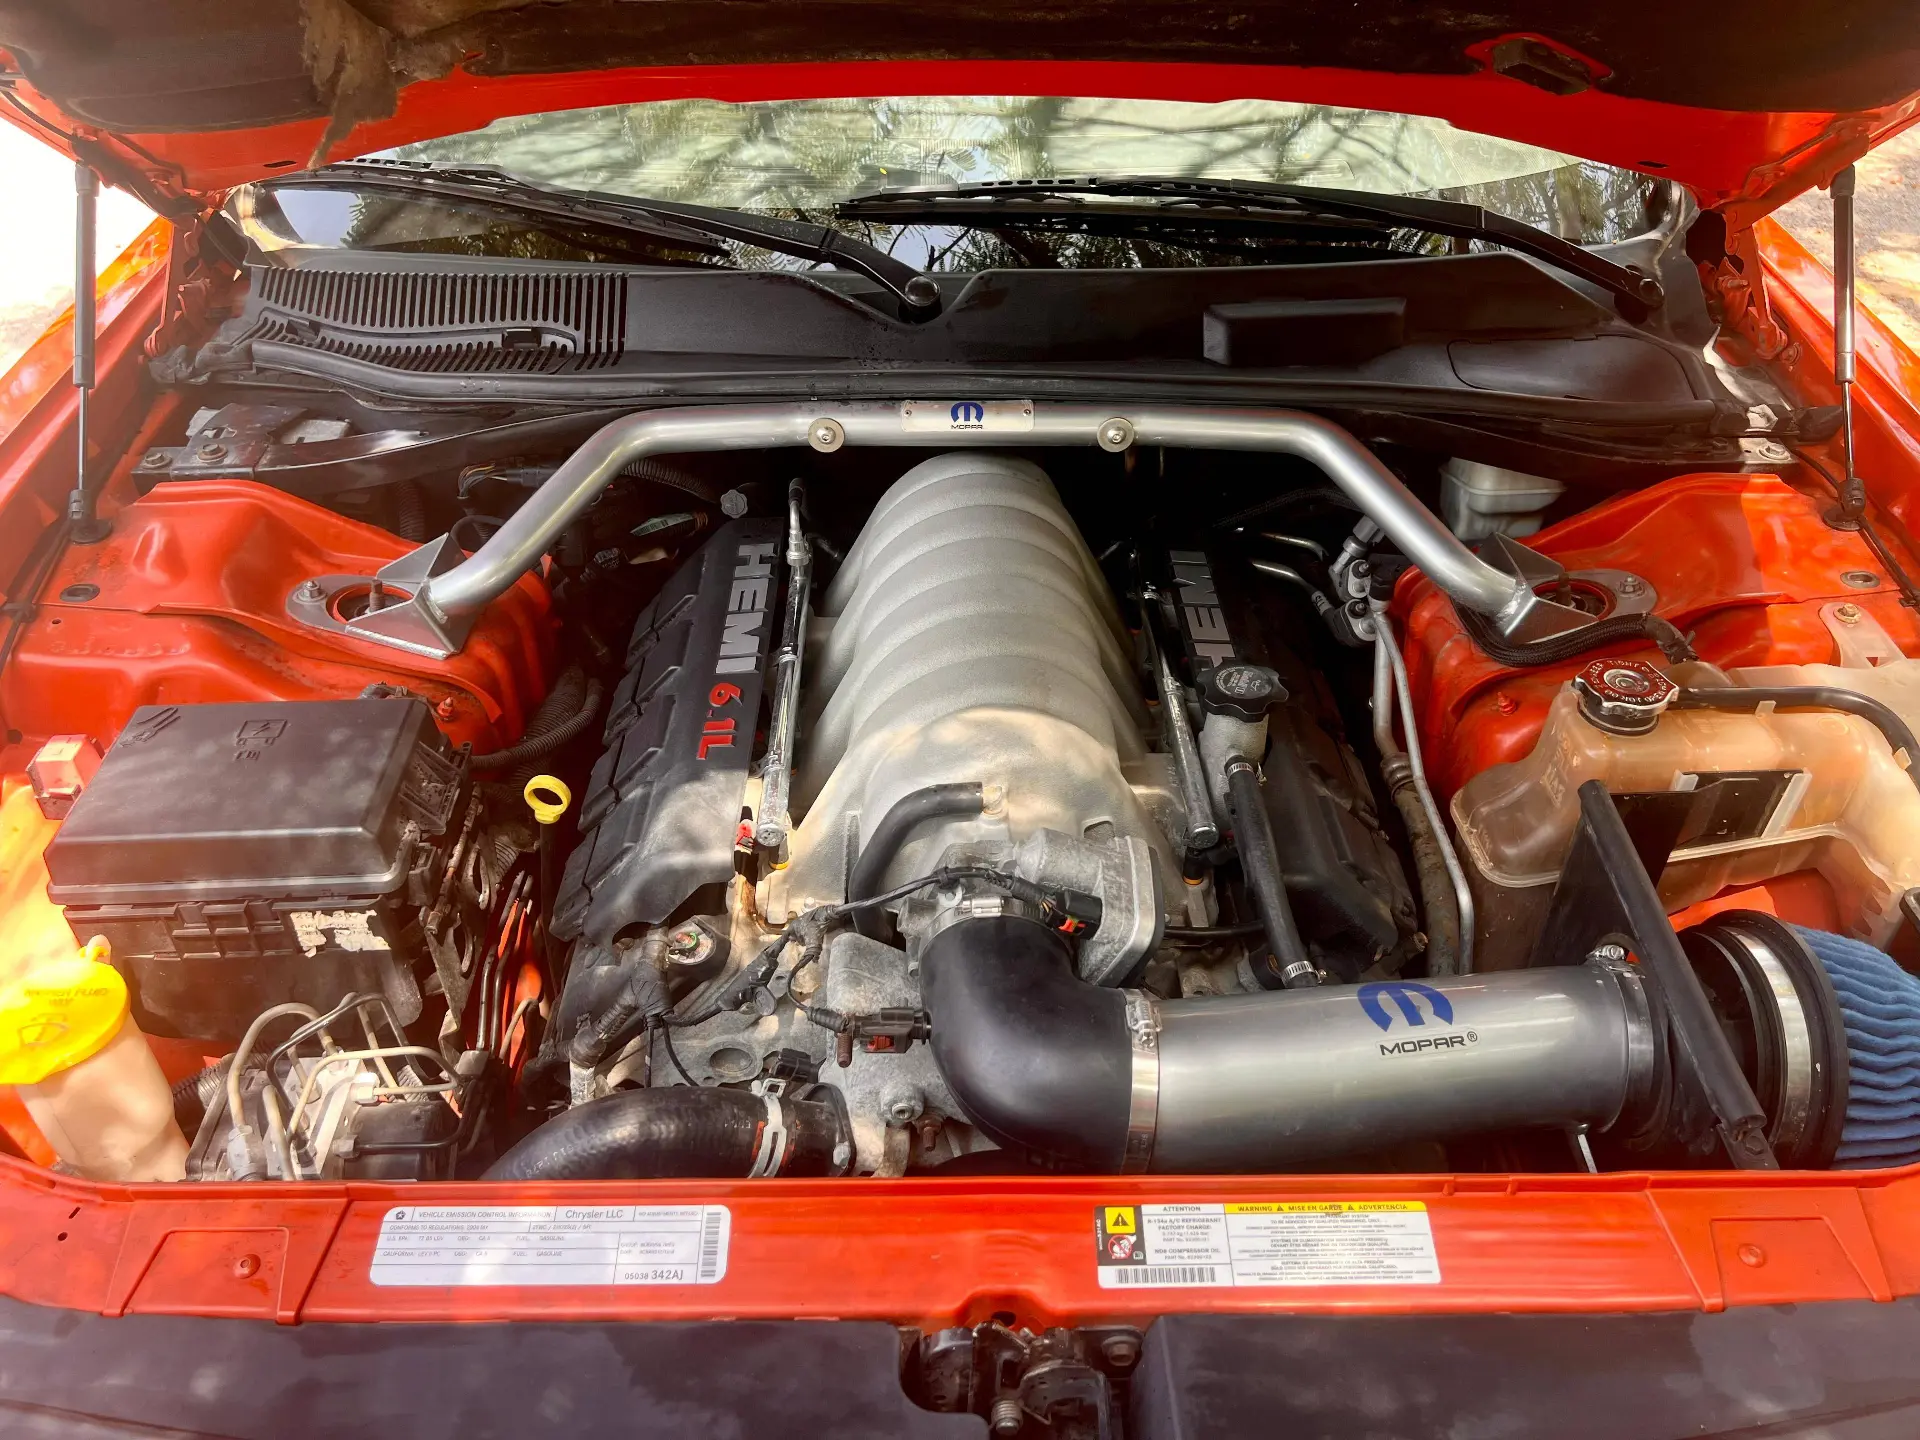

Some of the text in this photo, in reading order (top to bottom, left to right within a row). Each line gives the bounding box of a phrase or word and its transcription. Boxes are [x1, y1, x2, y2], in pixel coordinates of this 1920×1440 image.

[716, 542, 776, 674] HEMI
[696, 682, 742, 761] 6.1L
[565, 1209, 624, 1220] Chrysler LLC
[624, 1269, 684, 1280] 05038 342AJ
